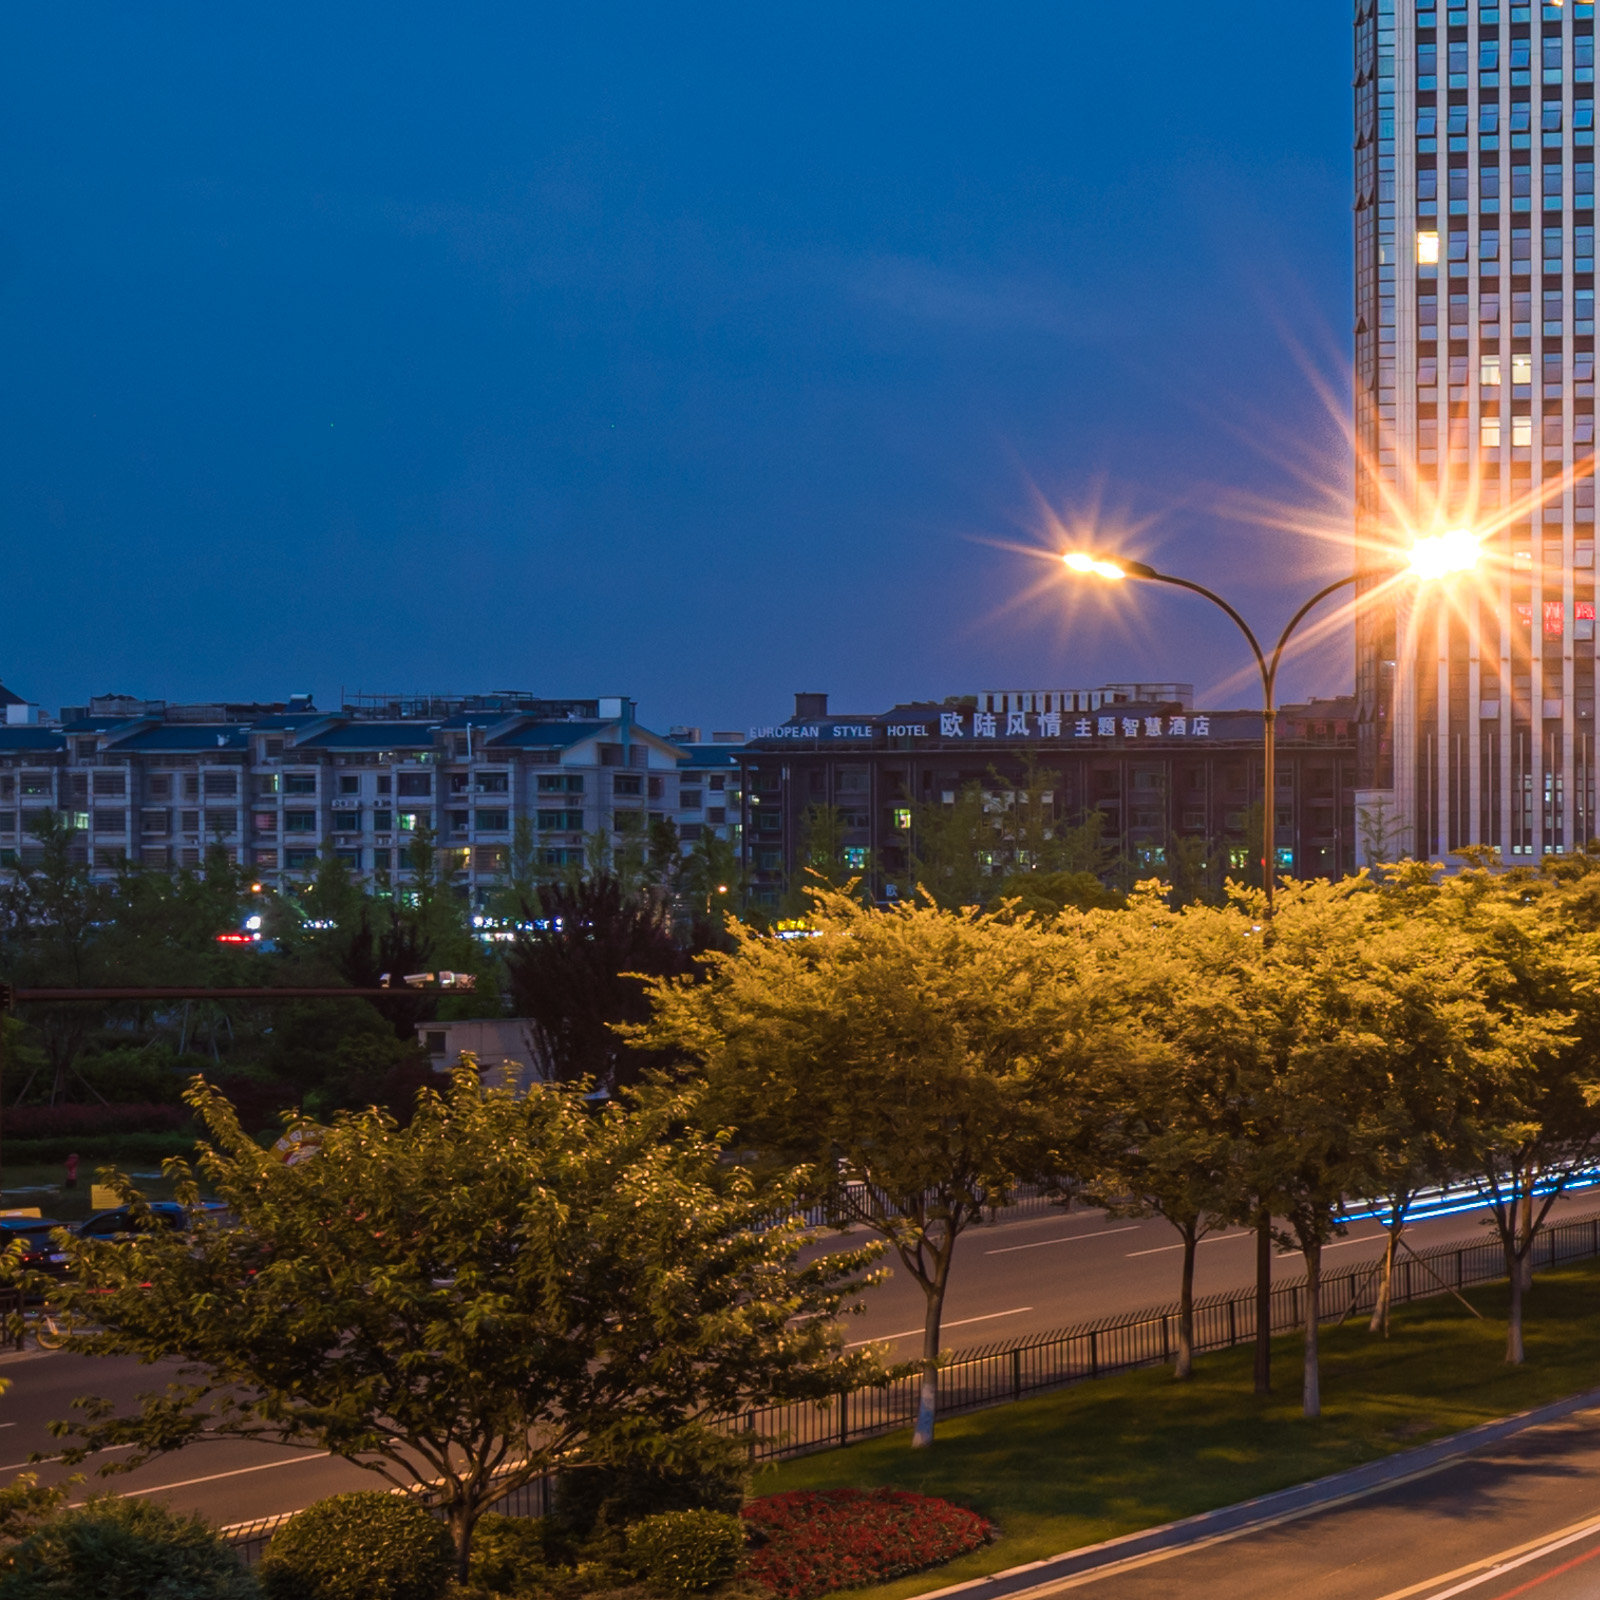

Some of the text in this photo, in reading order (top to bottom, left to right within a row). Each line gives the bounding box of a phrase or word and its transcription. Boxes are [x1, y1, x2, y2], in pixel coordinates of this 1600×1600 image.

[750, 724, 929, 738] EUROPEAN STYLE HOTEL
